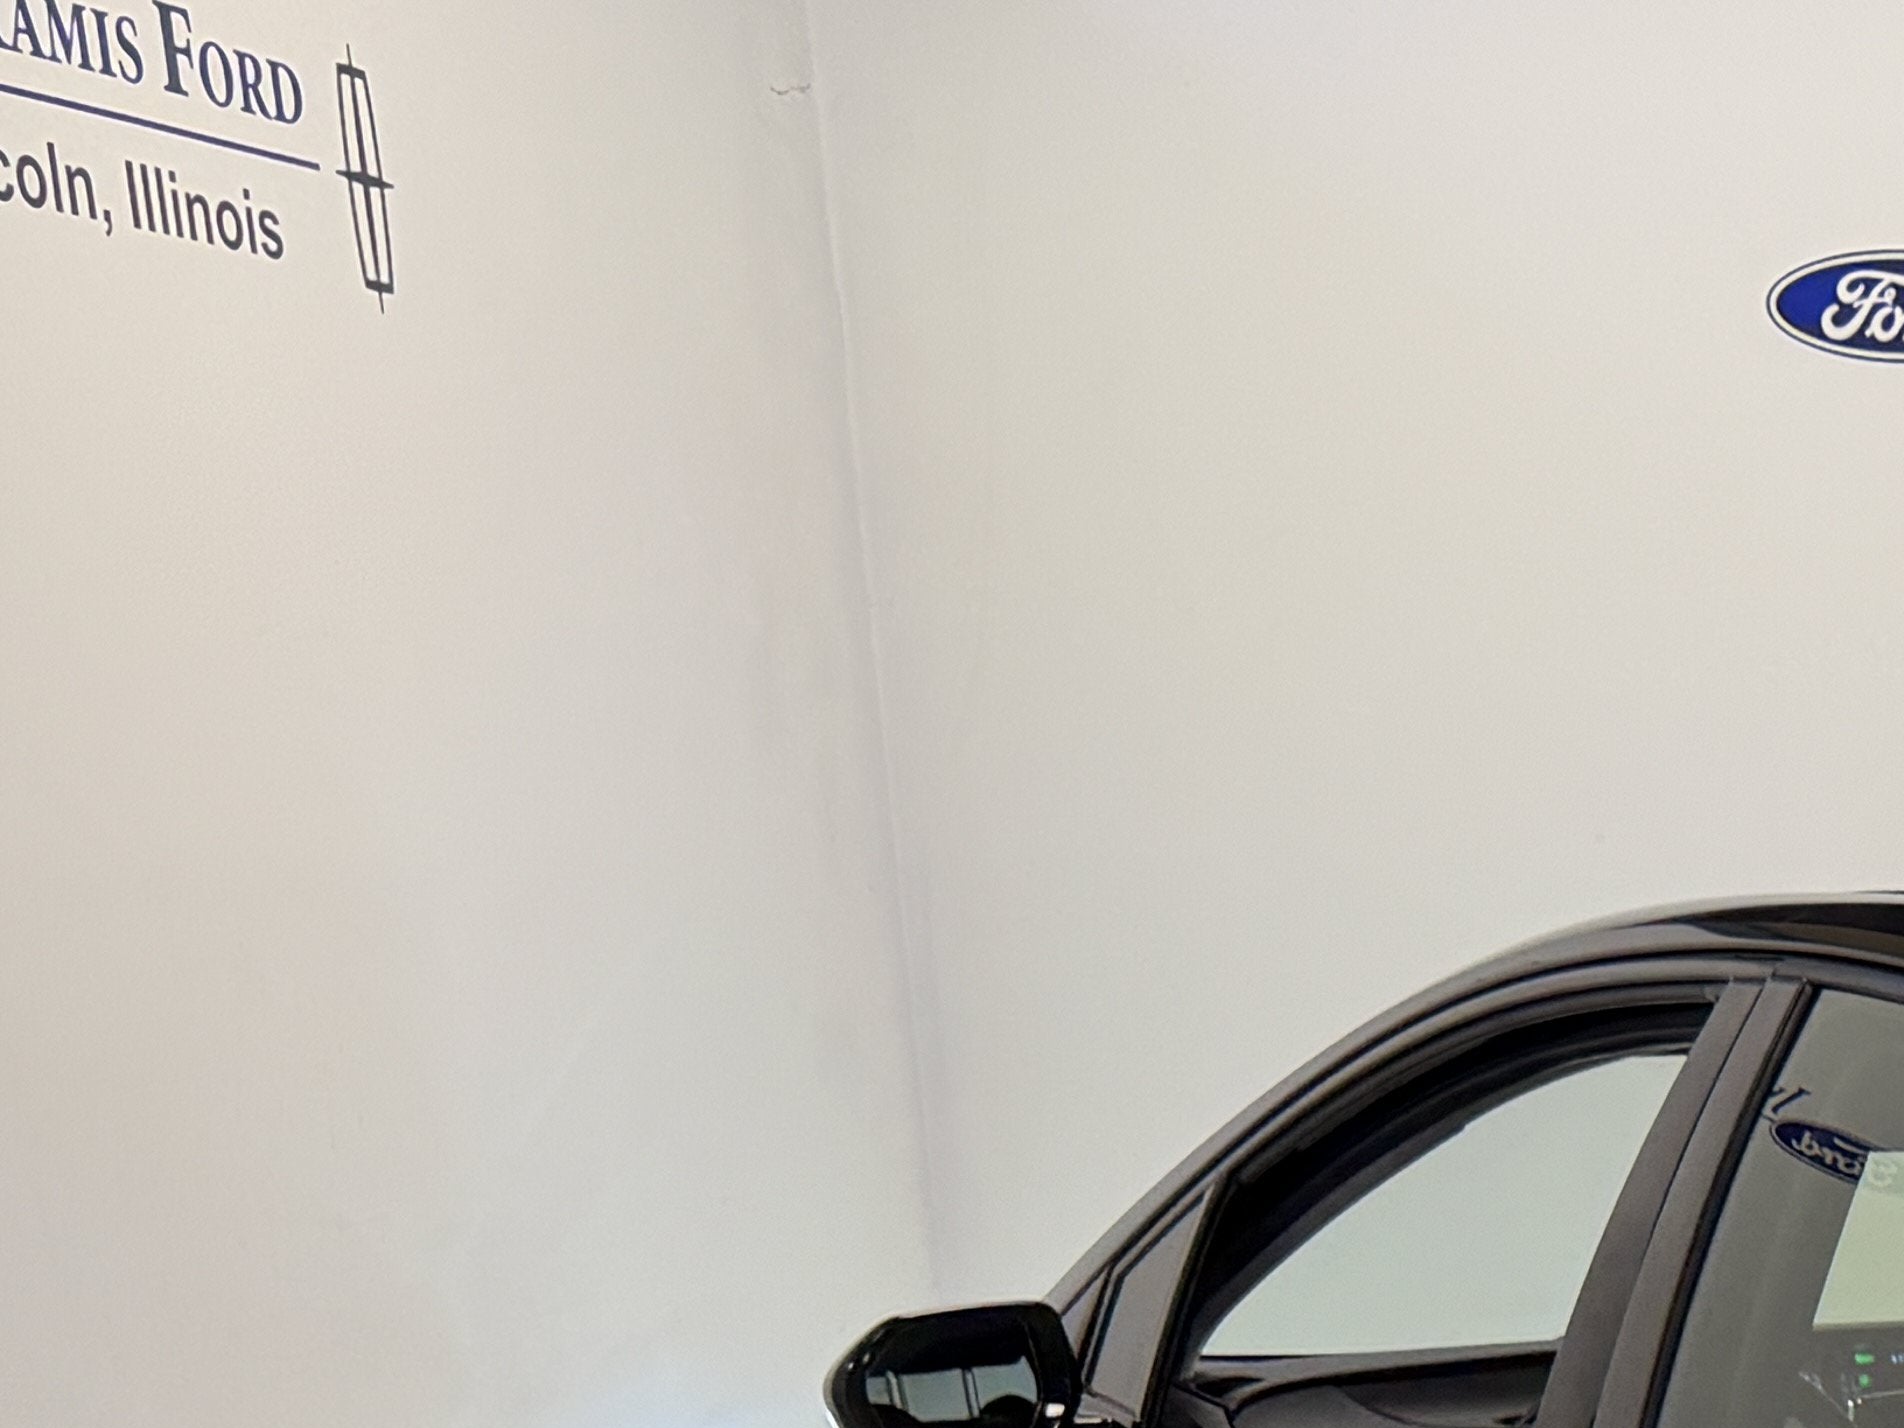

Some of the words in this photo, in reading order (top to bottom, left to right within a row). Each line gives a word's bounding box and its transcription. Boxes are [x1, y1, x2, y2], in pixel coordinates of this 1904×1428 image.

[0, 0, 144, 84] AMIS
[152, 0, 303, 125] FORD
[125, 160, 284, 260] Illinois
